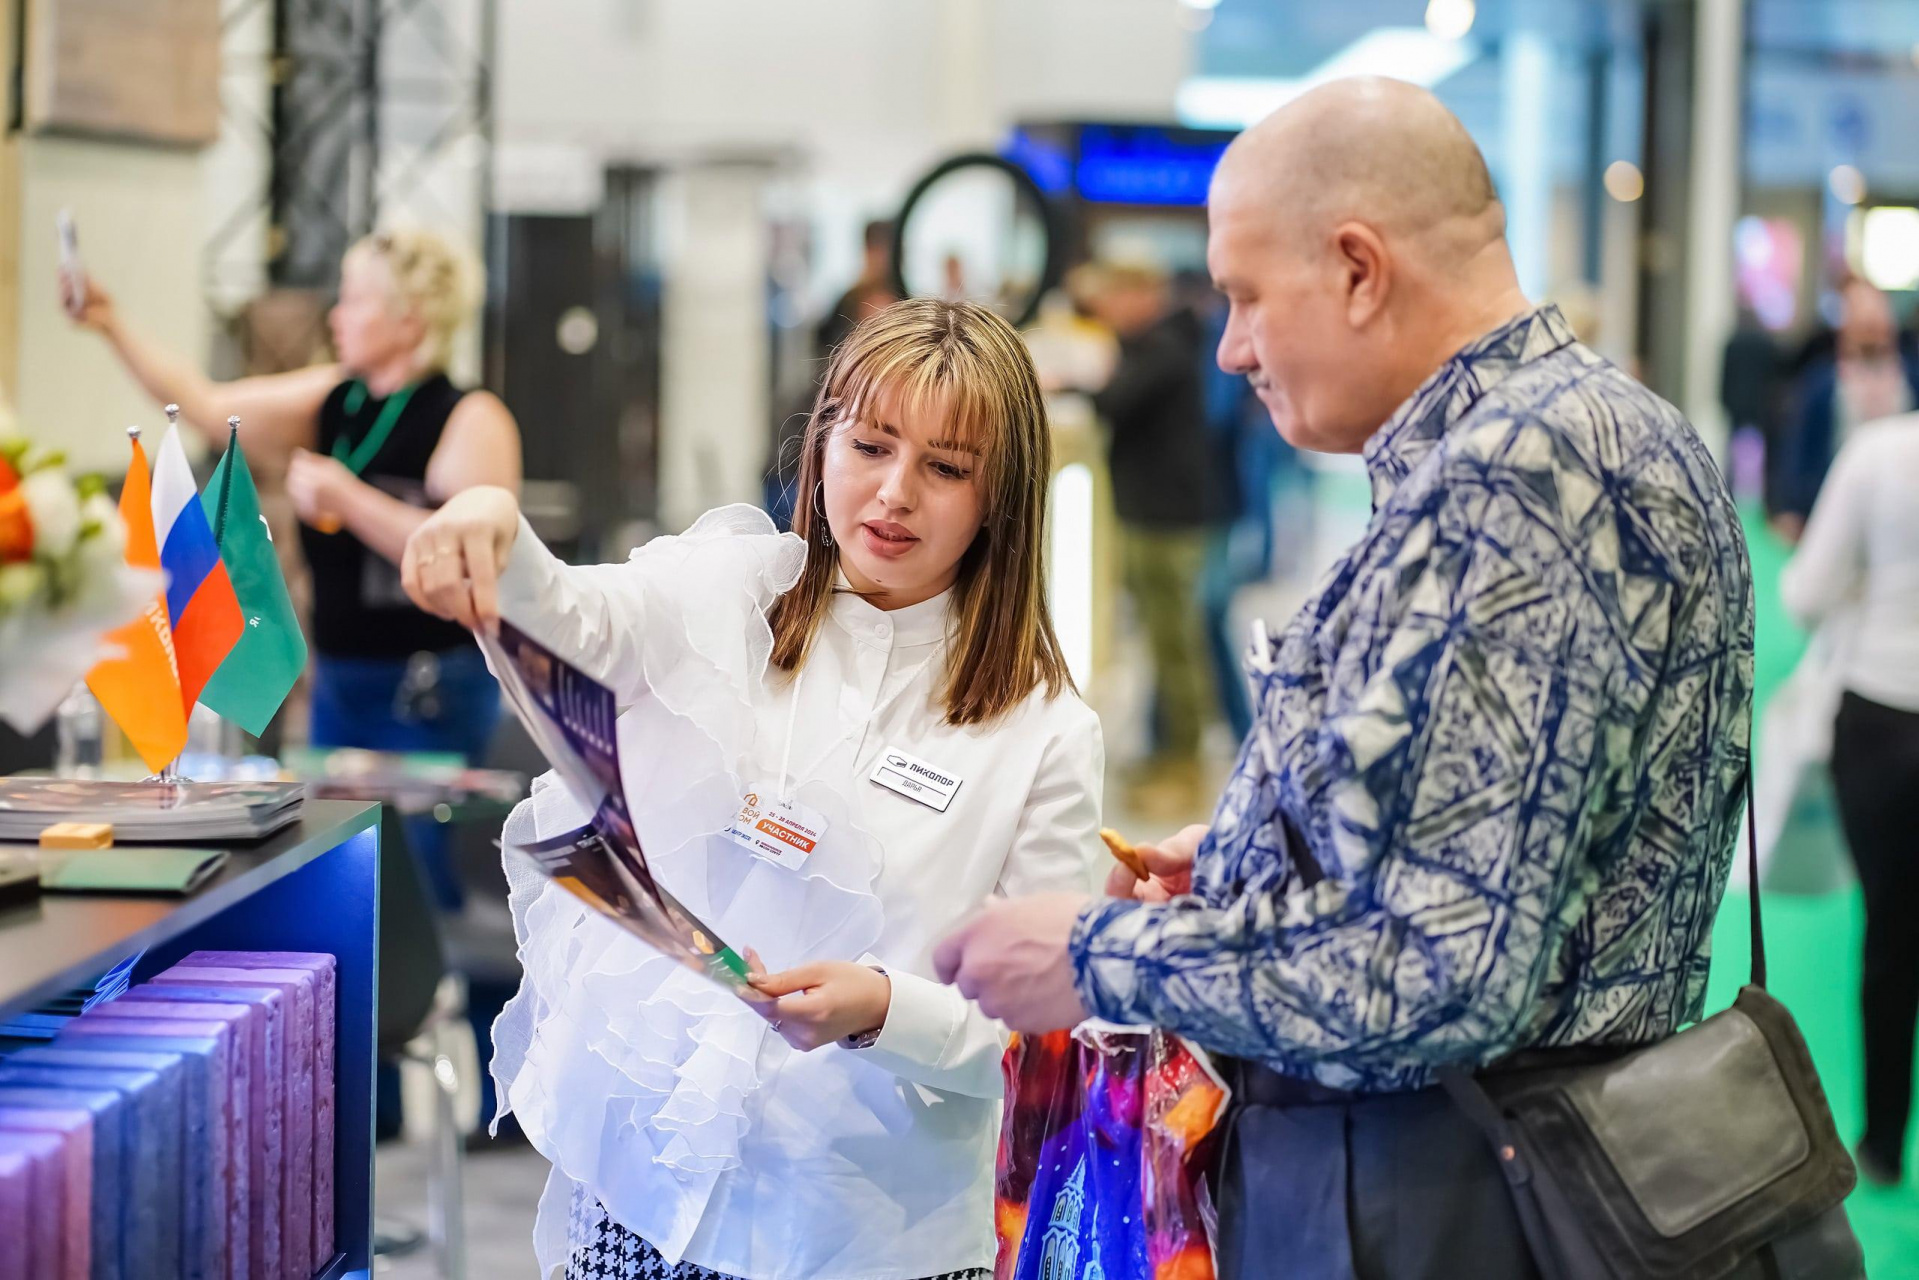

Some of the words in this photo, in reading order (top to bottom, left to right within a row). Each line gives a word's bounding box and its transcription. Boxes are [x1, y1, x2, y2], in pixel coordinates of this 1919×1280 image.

[909, 763, 954, 787] ЛИКОЛОР
[741, 807, 760, 819] ВОЙ
[761, 821, 810, 850] УЧАСТНИК
